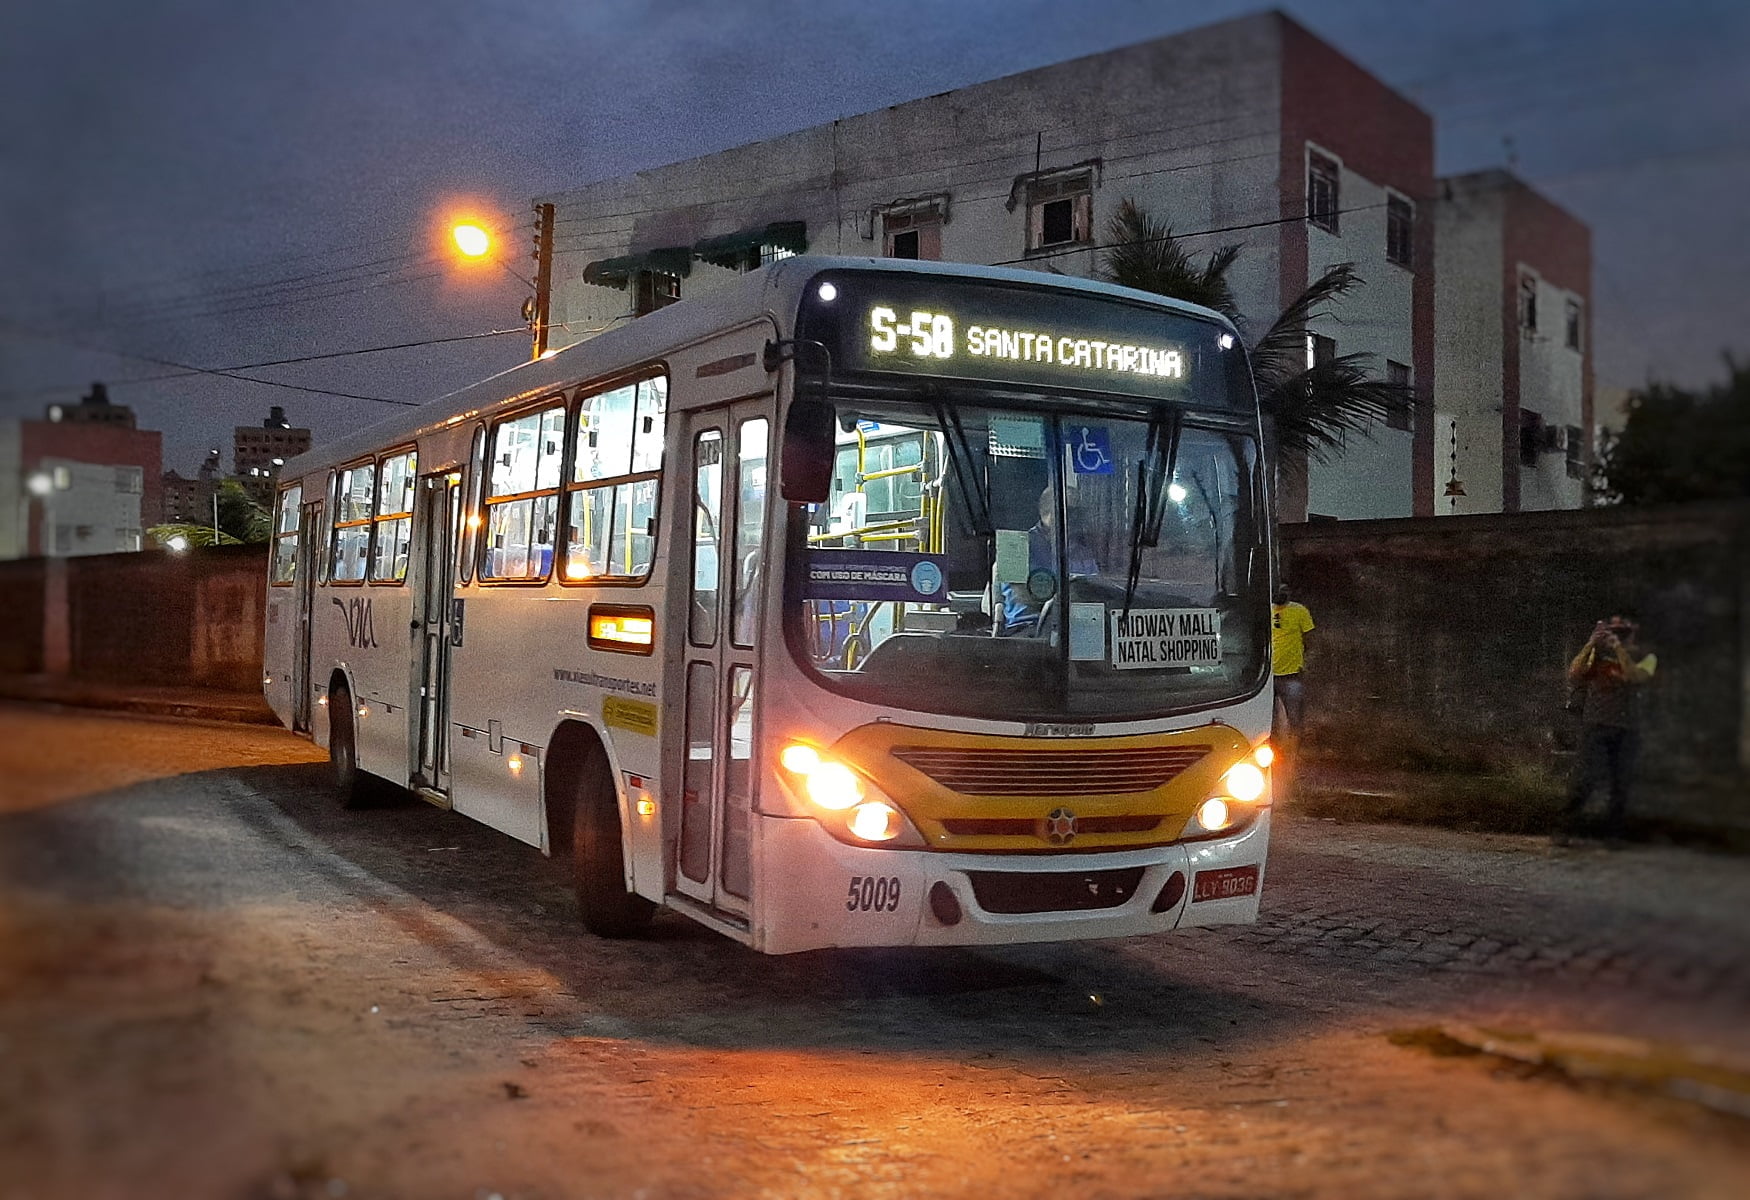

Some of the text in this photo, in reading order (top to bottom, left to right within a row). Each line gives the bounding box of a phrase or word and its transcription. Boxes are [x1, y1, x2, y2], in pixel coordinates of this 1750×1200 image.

[871, 307, 1181, 378] S-50 SANTA CATARINA
[810, 569, 907, 582] COM USO DE MÁSCARA
[1118, 613, 1216, 637] MIDWAY MALL
[1118, 639, 1218, 663] NATAL SHOPPING
[847, 876, 901, 912] 5009
